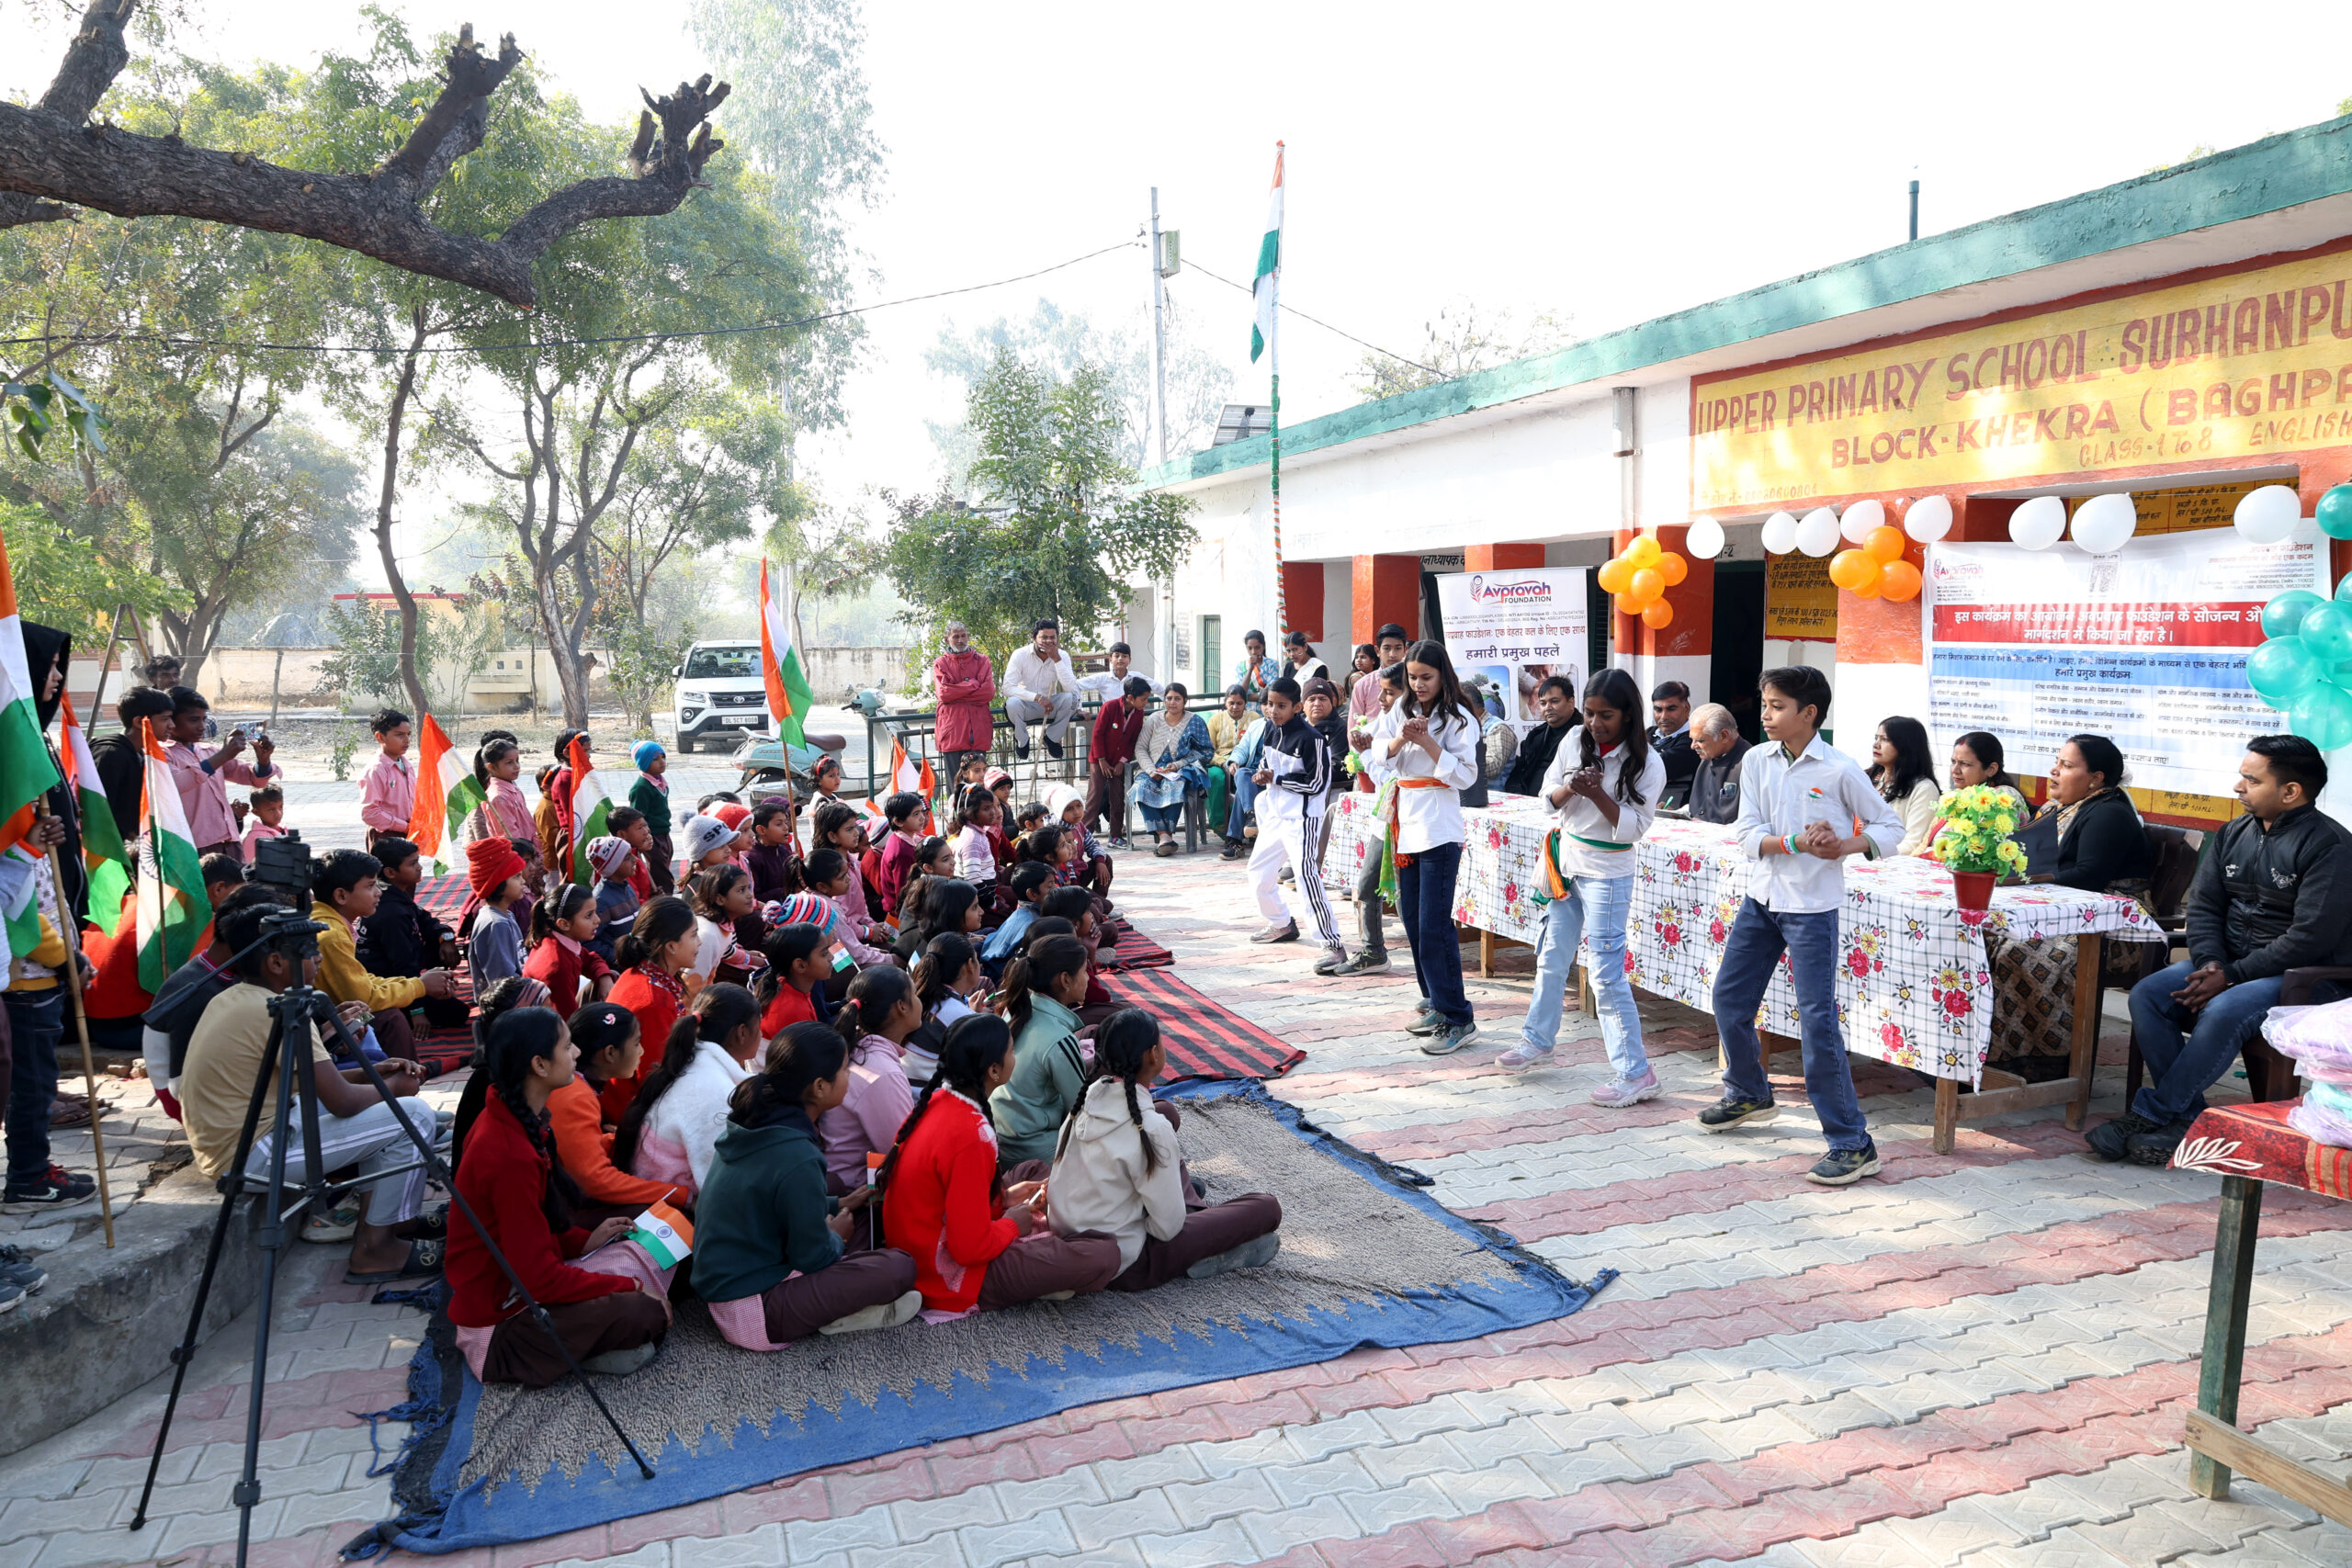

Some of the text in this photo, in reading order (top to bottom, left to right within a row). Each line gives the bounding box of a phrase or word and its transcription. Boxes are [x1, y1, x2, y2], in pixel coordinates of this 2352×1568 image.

[1697, 389, 1778, 437] UPPER
[1787, 358, 1938, 427] PRIMARY
[1946, 330, 2101, 401] SCHOOL
[1482, 581, 1551, 604] Avpravah
[1954, 611, 1971, 625] इस
[1972, 607, 2013, 623] कार्यक्रम
[2014, 610, 2029, 622] का
[2030, 606, 2075, 623] आयोजन
[2177, 607, 2192, 623] के
[2193, 606, 2241, 624] सौजन्य
[2245, 605, 2263, 624] औ
[1560, 626, 1571, 635] एक
[1572, 626, 1587, 634] साथ
[2023, 626, 2070, 640] मार्गदर्शन
[2072, 626, 2085, 640] में
[2086, 626, 2113, 641] किया
[2117, 629, 2133, 642] जा
[2136, 630, 2154, 643] रहा
[1465, 645, 1498, 659] हमारी
[1500, 647, 1531, 661] प्रमुख
[2119, 657, 2147, 667] कार्यक्रमों
[2149, 659, 2155, 667] के
[2157, 660, 2182, 668] माध्यम
[2184, 660, 2190, 669] से
[2192, 660, 2206, 670] एक
[2208, 660, 2230, 670] बेहतर
[2054, 667, 2075, 678] हमारे
[2075, 669, 2097, 681] प्रमुख
